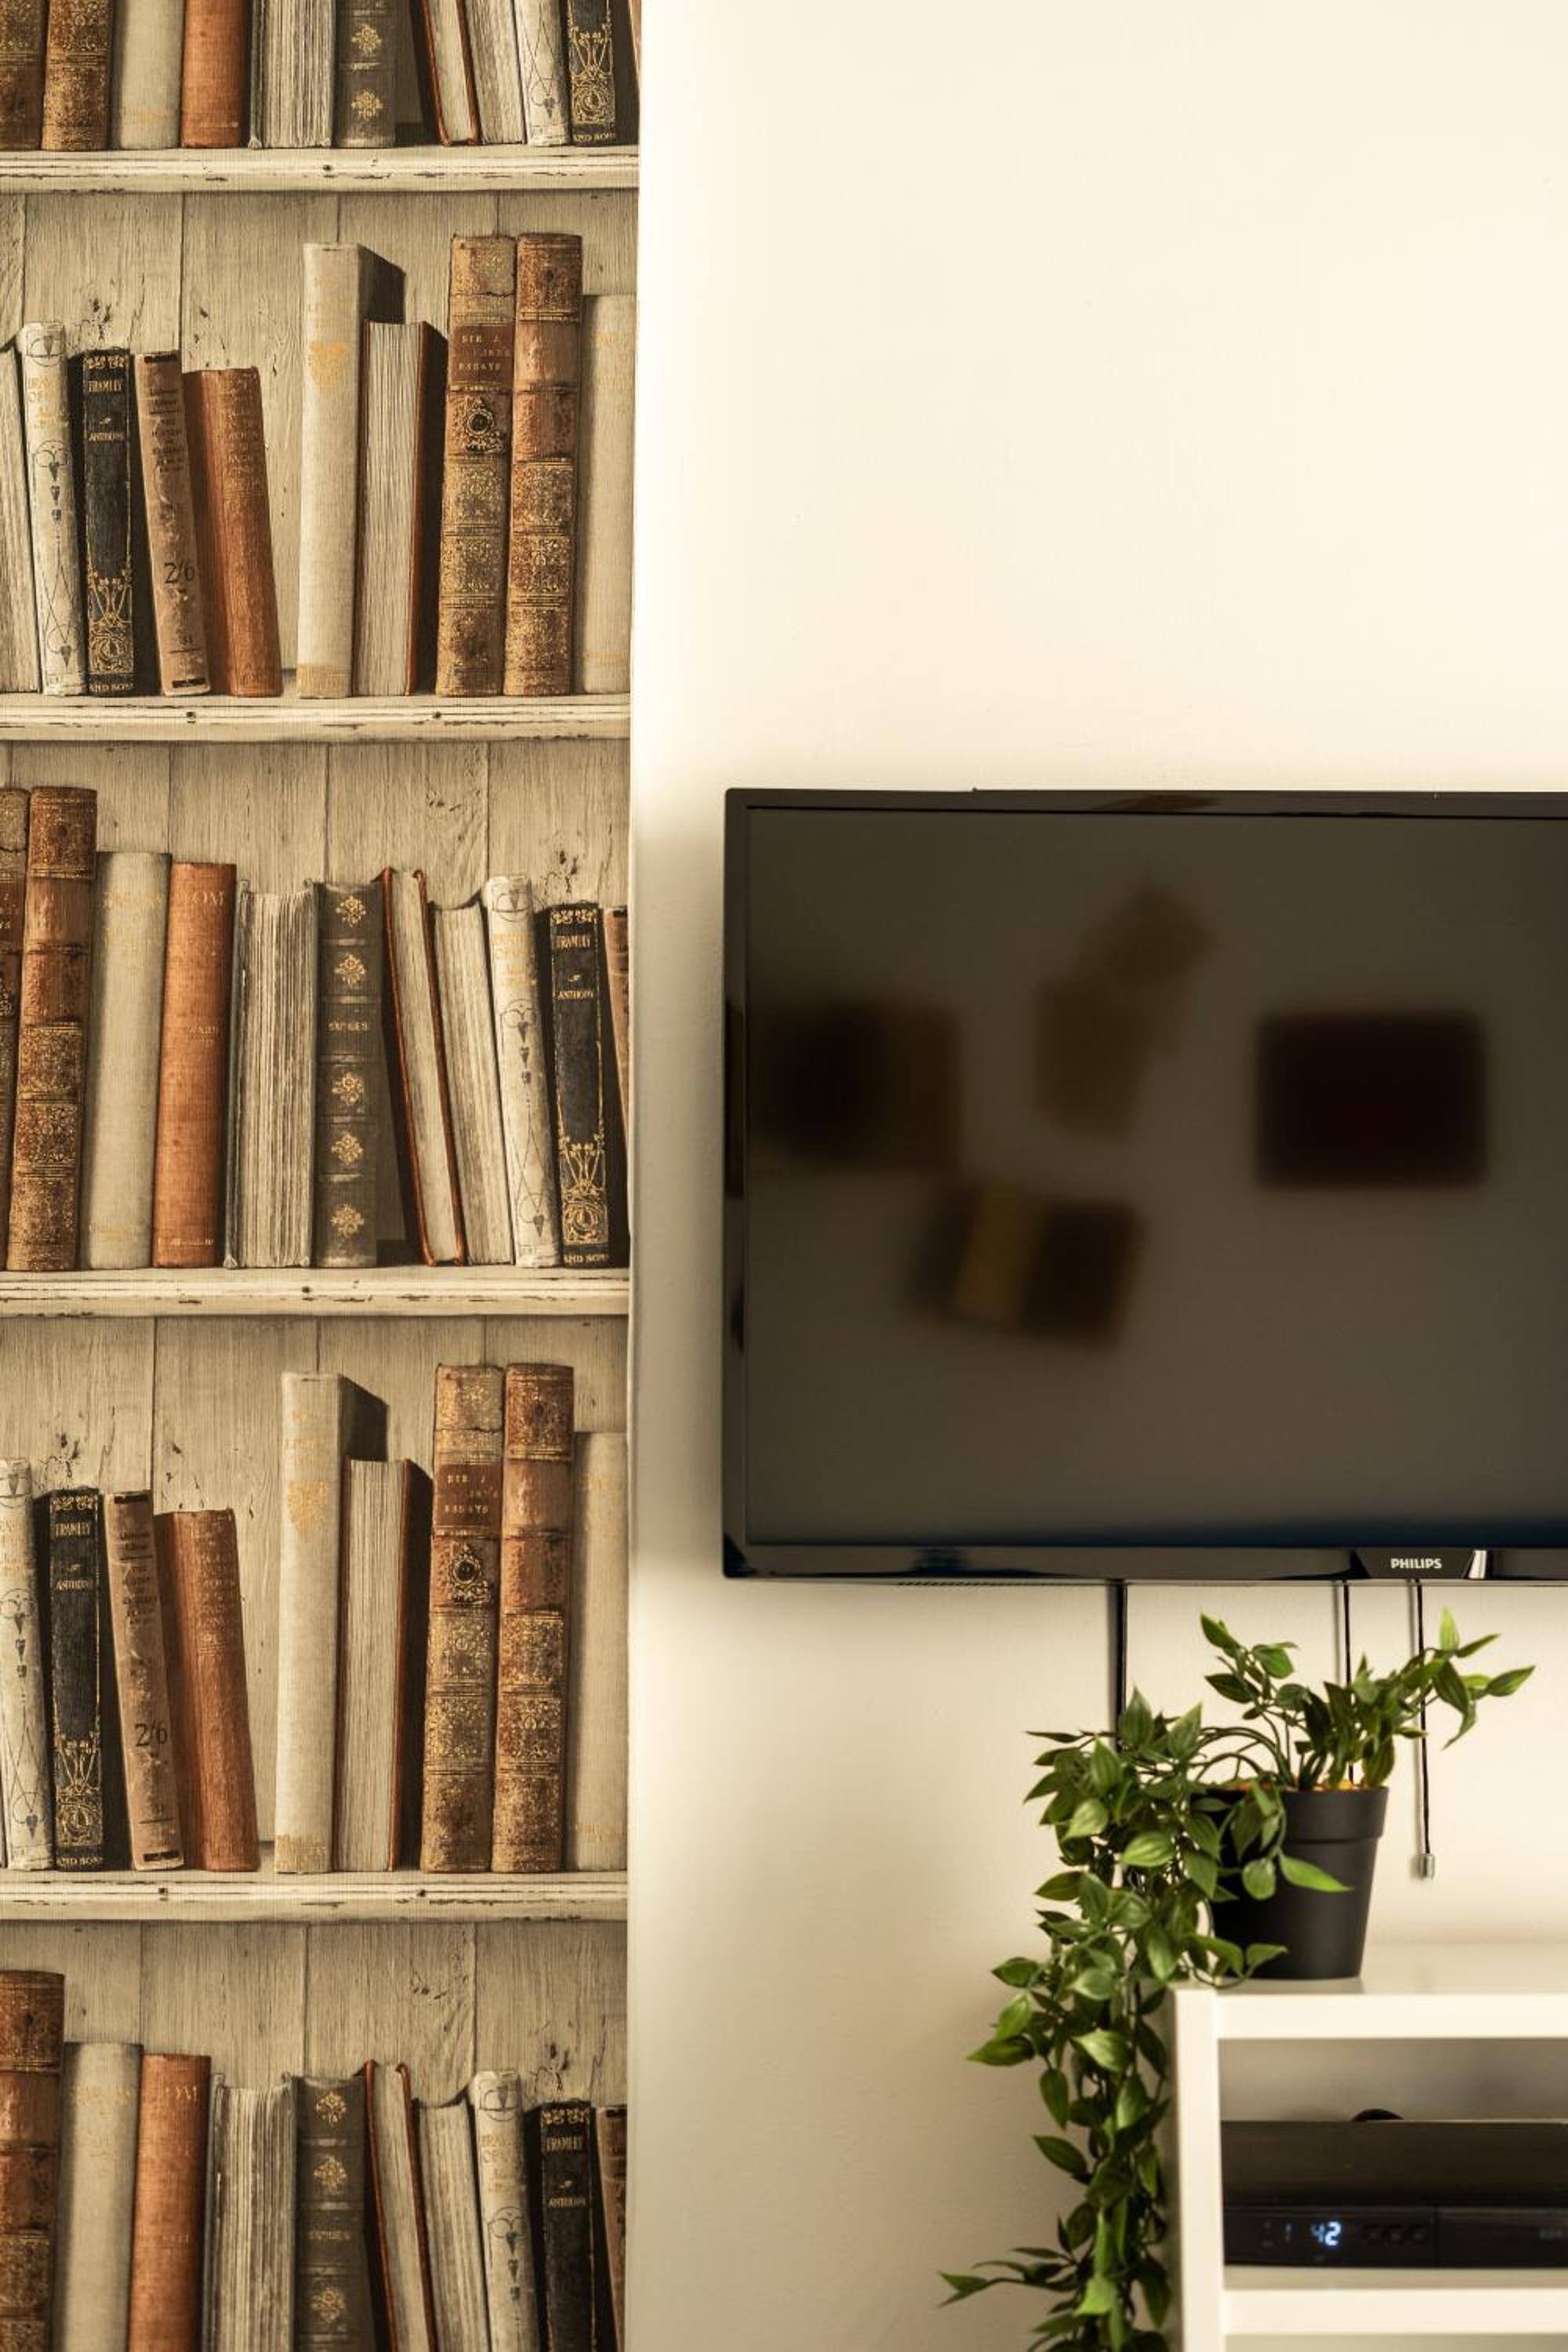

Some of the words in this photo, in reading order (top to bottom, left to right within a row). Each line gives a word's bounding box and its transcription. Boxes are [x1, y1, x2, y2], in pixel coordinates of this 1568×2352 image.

[164, 561, 195, 584] 2/6
[1390, 1558, 1443, 1569] PHILIPS
[134, 1721, 168, 1747] 2/6
[1310, 2220, 1342, 2246] 42
